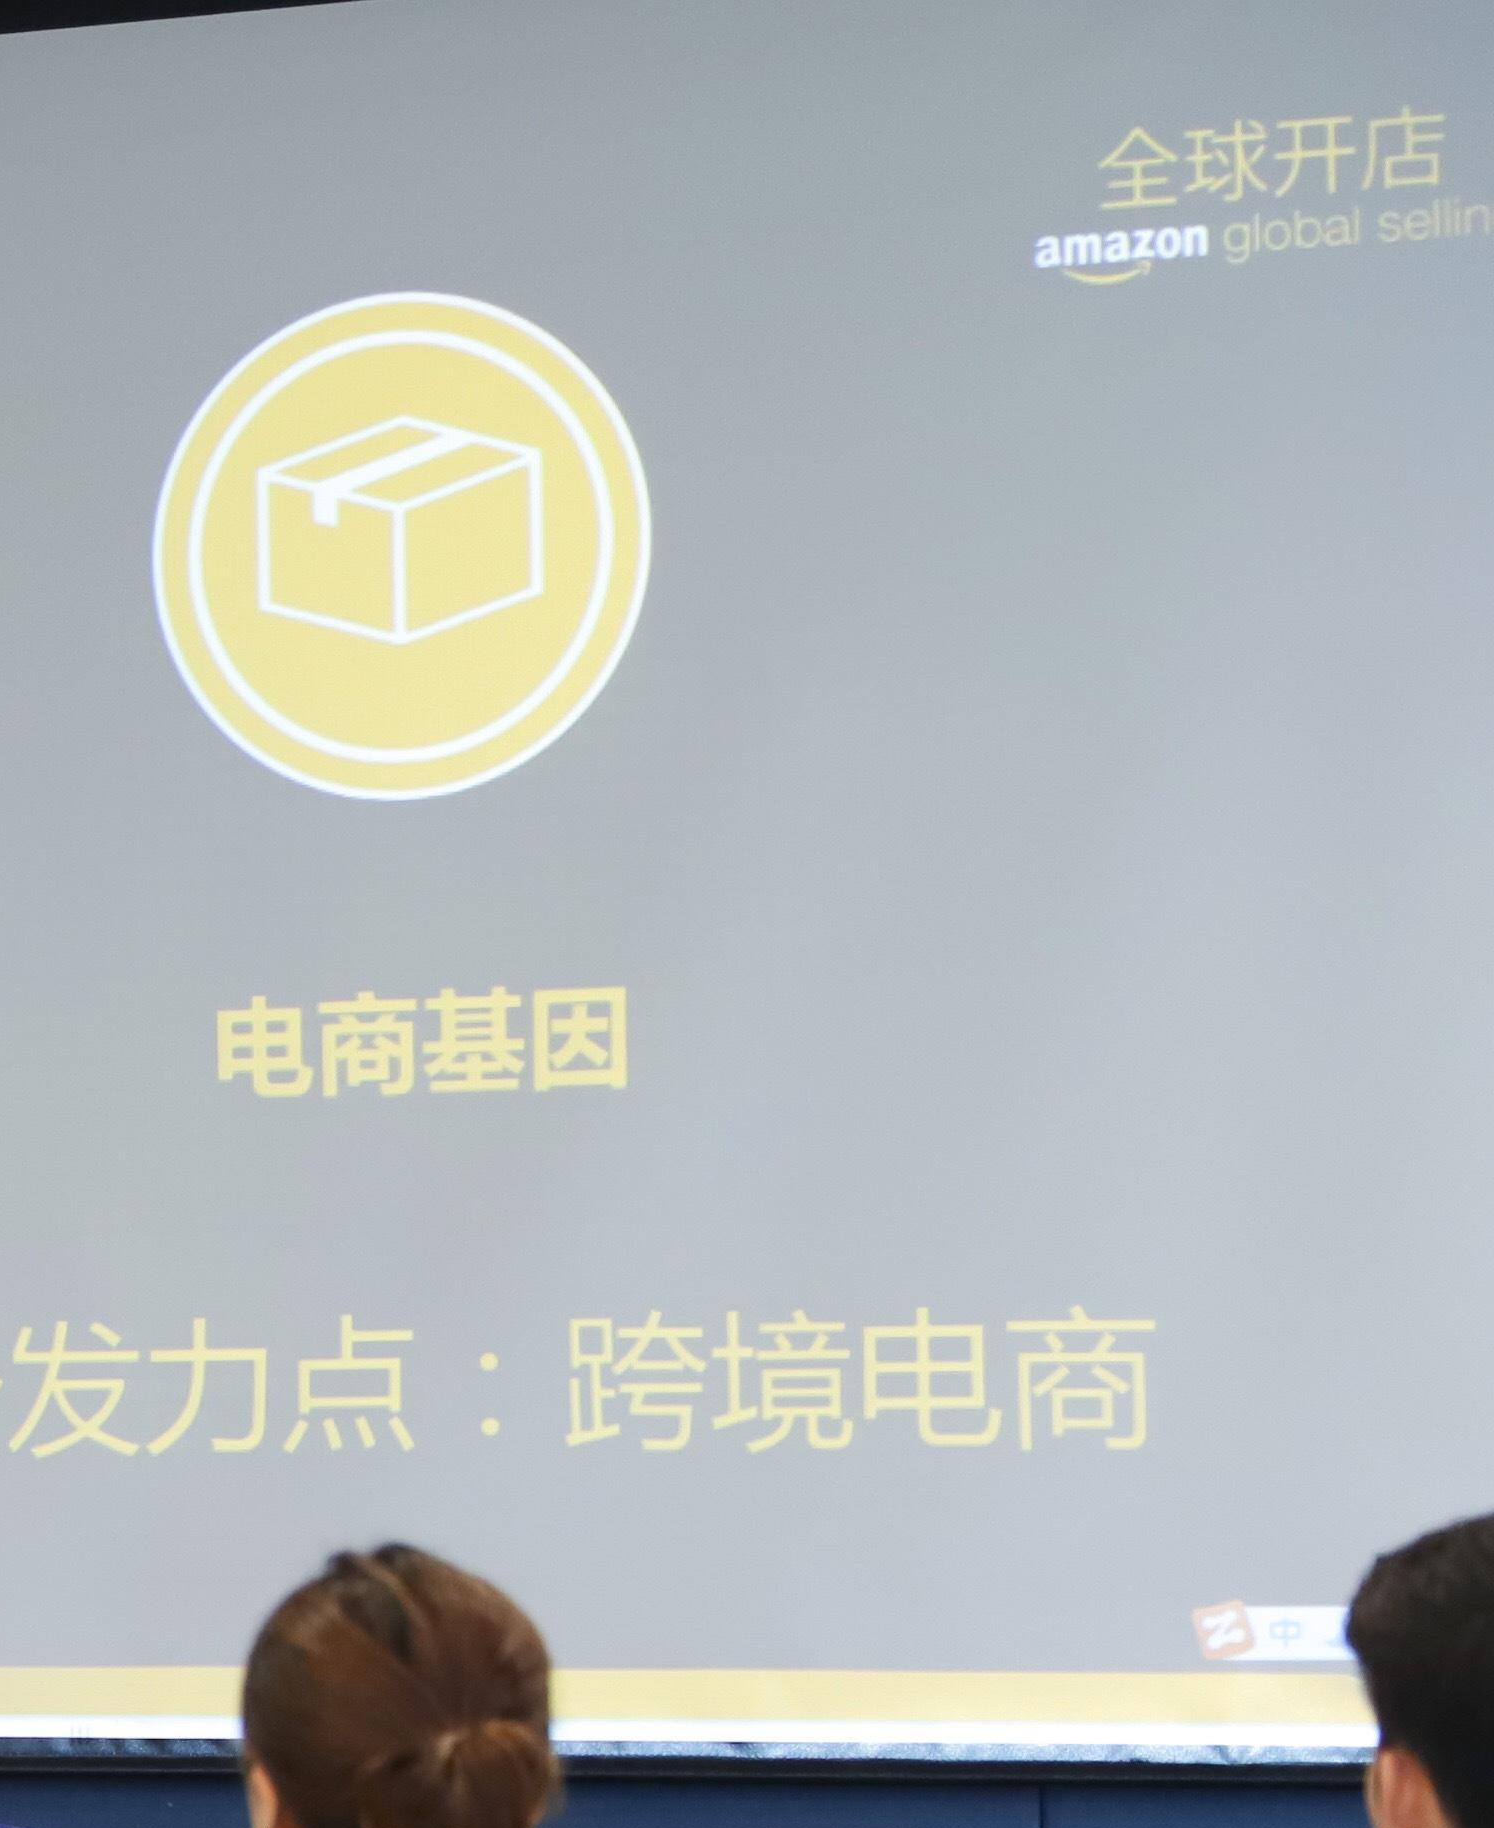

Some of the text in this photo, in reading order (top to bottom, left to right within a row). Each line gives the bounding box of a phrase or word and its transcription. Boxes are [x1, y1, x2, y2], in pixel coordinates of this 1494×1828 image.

[1097, 105, 1447, 210] 全球开店
[1033, 223, 1210, 269] amazon
[1222, 206, 1361, 264] global
[216, 985, 630, 1100] 电商基因
